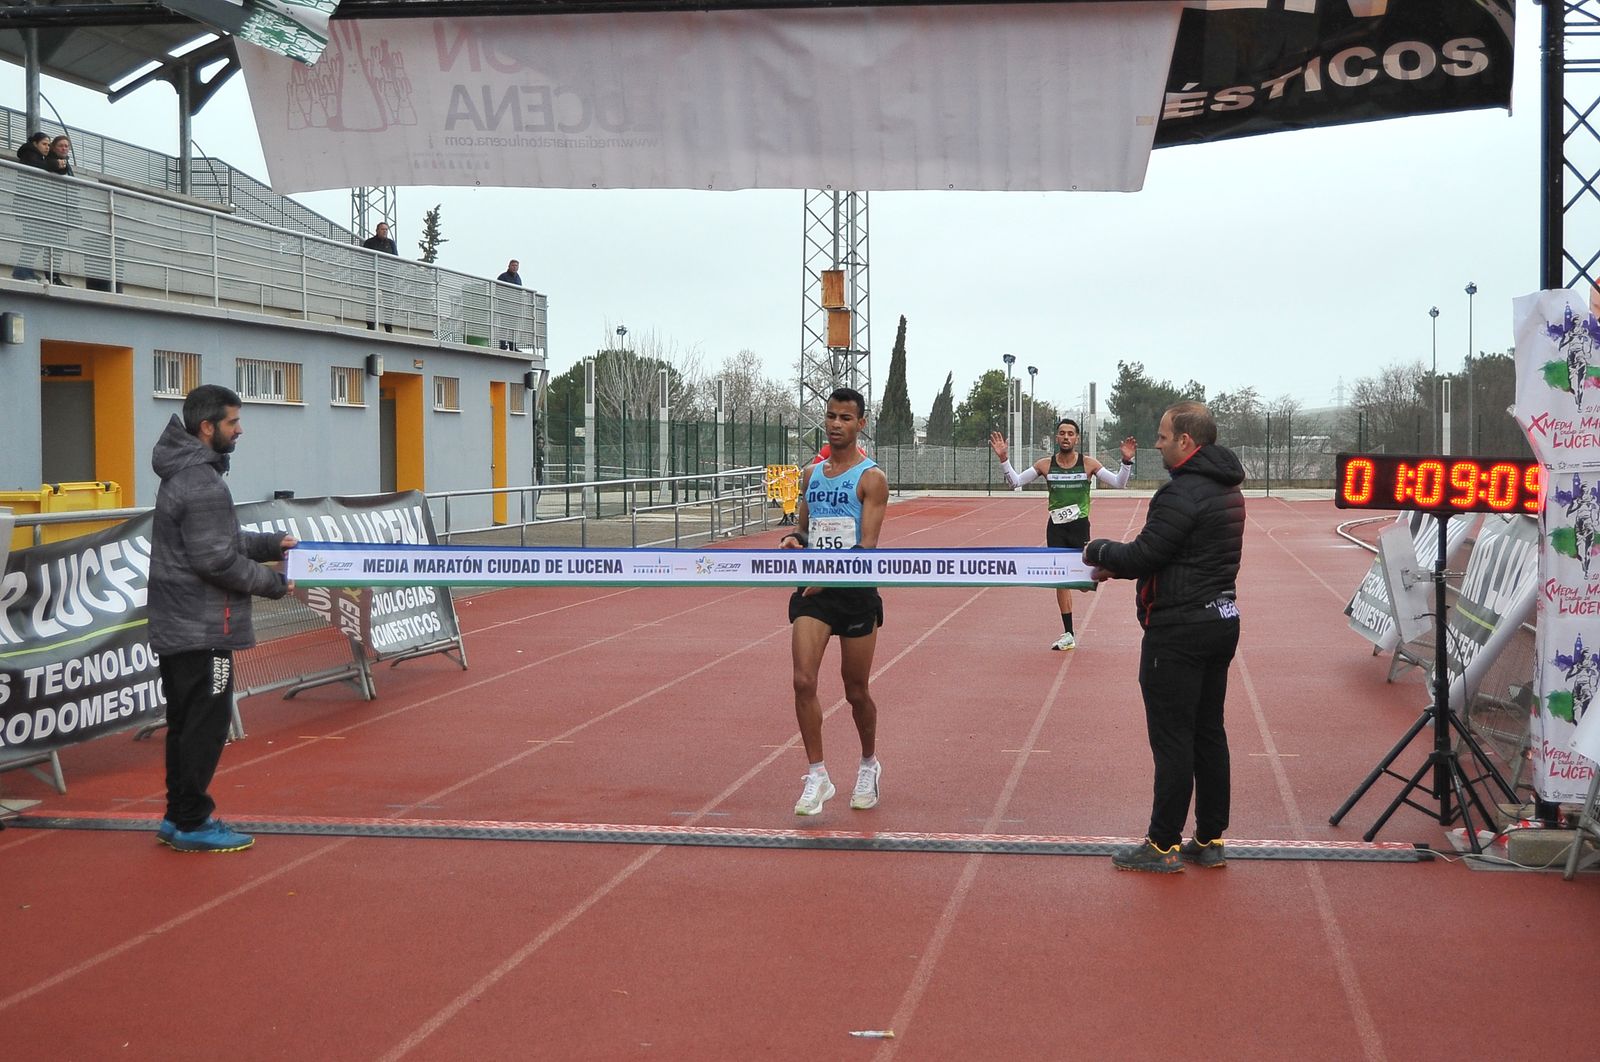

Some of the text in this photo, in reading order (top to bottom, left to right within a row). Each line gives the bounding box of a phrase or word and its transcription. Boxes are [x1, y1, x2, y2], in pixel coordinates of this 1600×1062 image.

[808, 487, 849, 507] nerja
[1058, 508, 1074, 521] 393
[816, 536, 843, 549] 456
[364, 556, 623, 574] MEDIA MARATÓN CIUDAD DE LUCENA
[752, 556, 1017, 575] MEDIA MARATÓN CIUDAD DE LUCENA
[0, 676, 167, 748] ODOMESTIC
